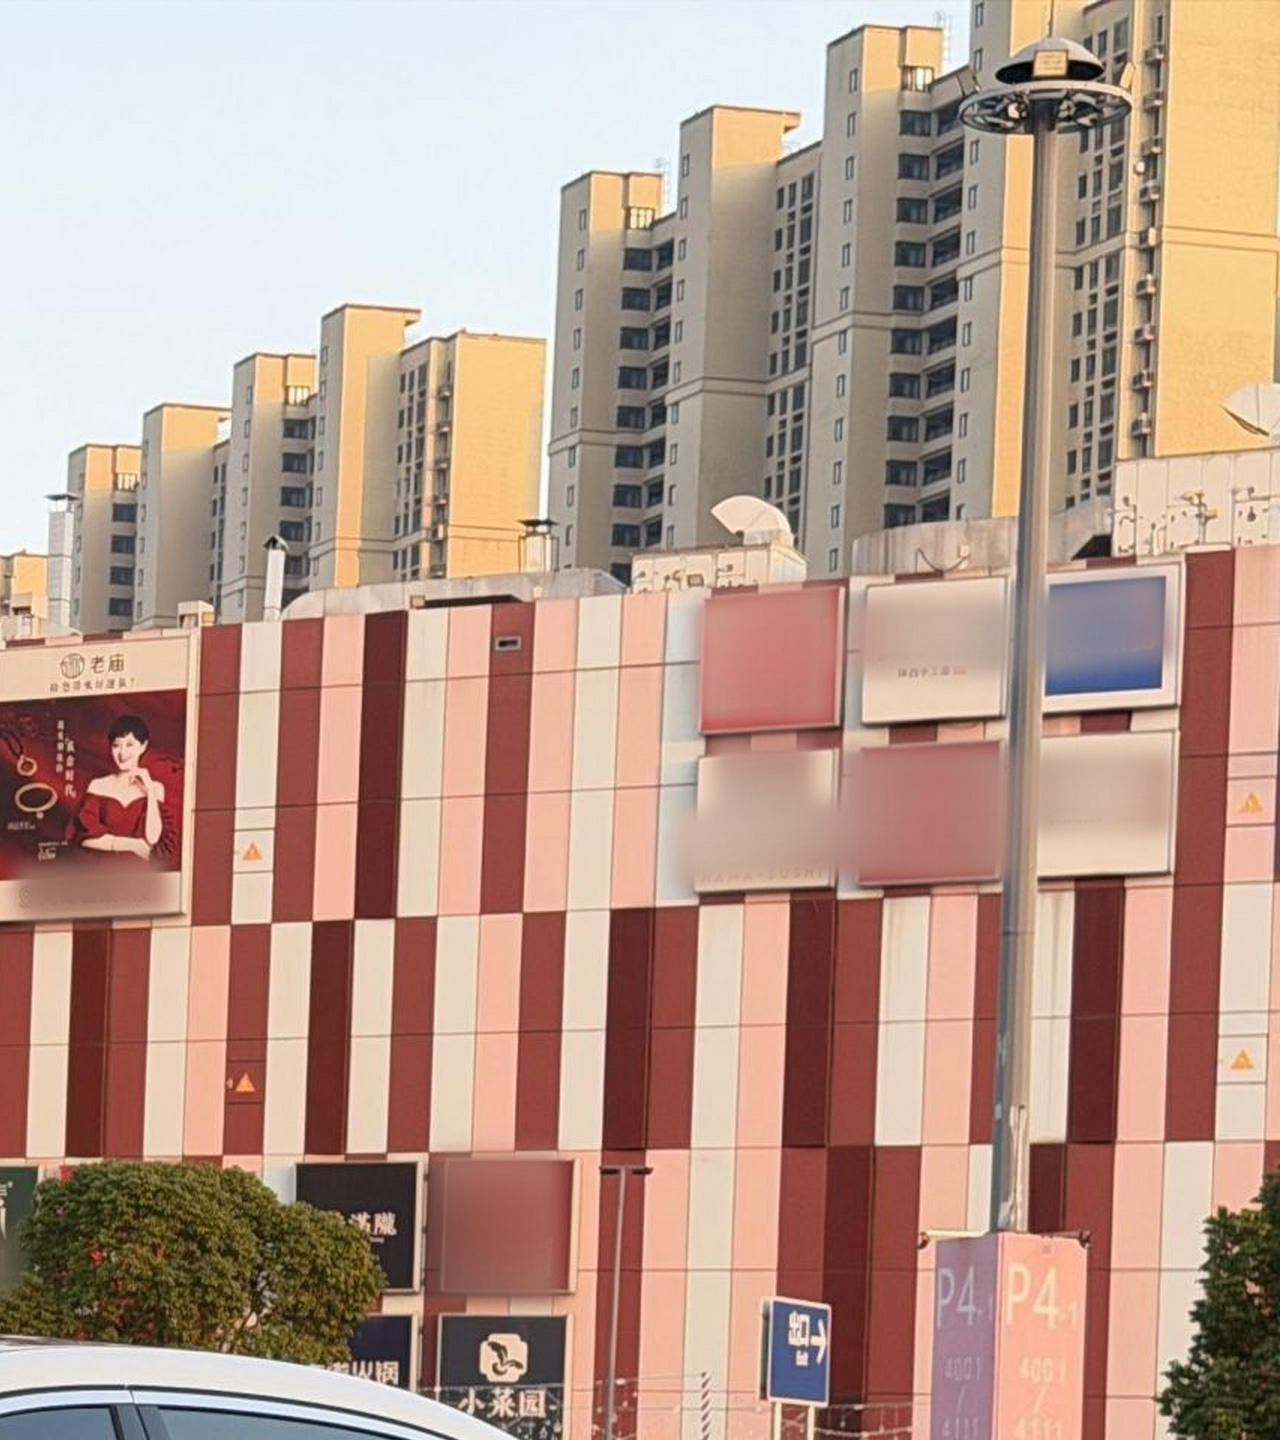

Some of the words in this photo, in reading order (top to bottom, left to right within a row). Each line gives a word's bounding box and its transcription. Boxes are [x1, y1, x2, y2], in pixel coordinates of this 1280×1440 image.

[90, 654, 124, 673] 老庙
[1018, 1356, 1067, 1384] 4001
[458, 1388, 547, 1418] 小菜园
